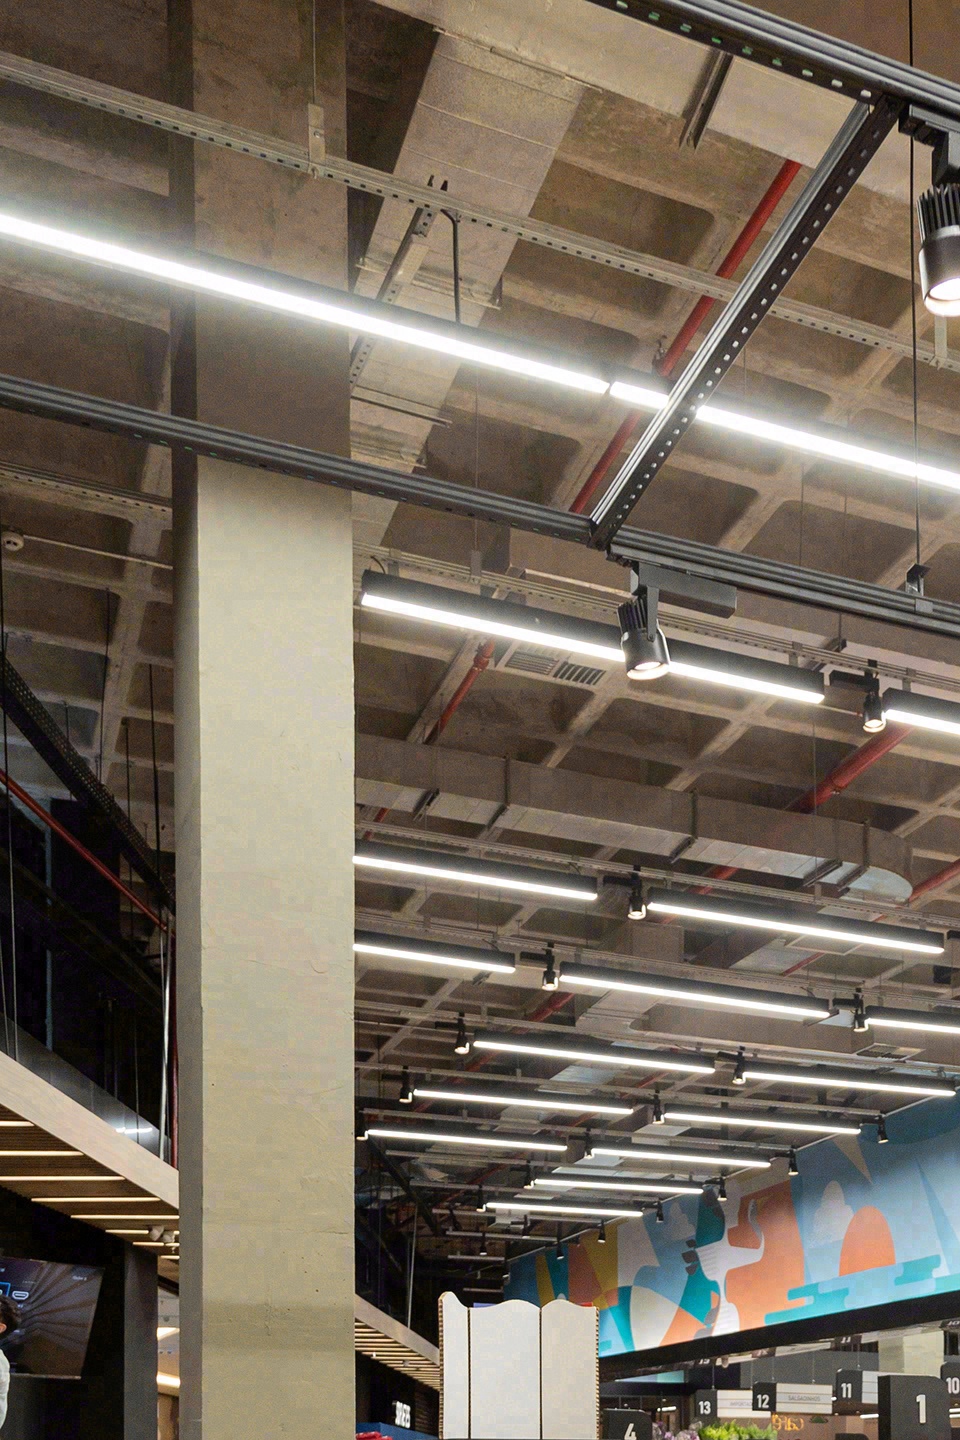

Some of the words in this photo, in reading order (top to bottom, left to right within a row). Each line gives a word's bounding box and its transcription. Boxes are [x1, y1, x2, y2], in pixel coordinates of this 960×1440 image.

[840, 1382, 852, 1398] 11
[946, 1377, 960, 1394] 10
[698, 1400, 711, 1415] 13
[757, 1394, 770, 1409] 12
[915, 1394, 927, 1424] 1
